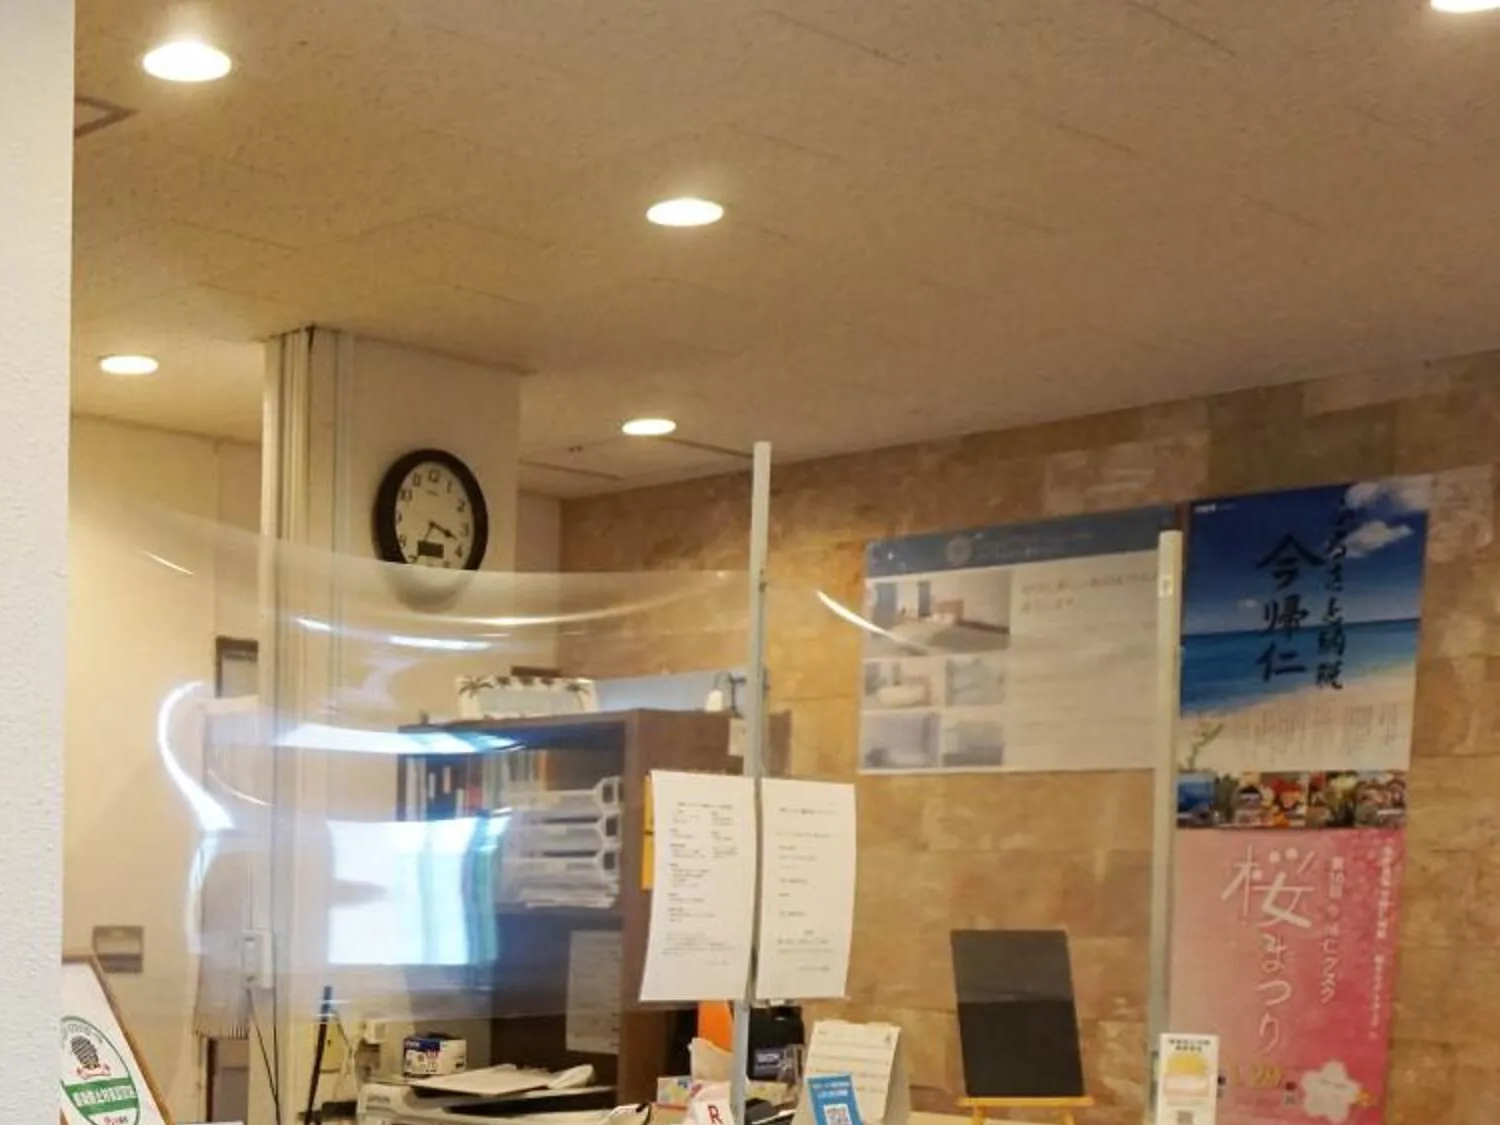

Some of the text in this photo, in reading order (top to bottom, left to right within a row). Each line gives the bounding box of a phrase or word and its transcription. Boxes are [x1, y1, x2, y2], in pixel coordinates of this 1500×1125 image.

[1254, 532, 1327, 683] 今帰仁
[1220, 844, 1316, 1050] 桜まつり
